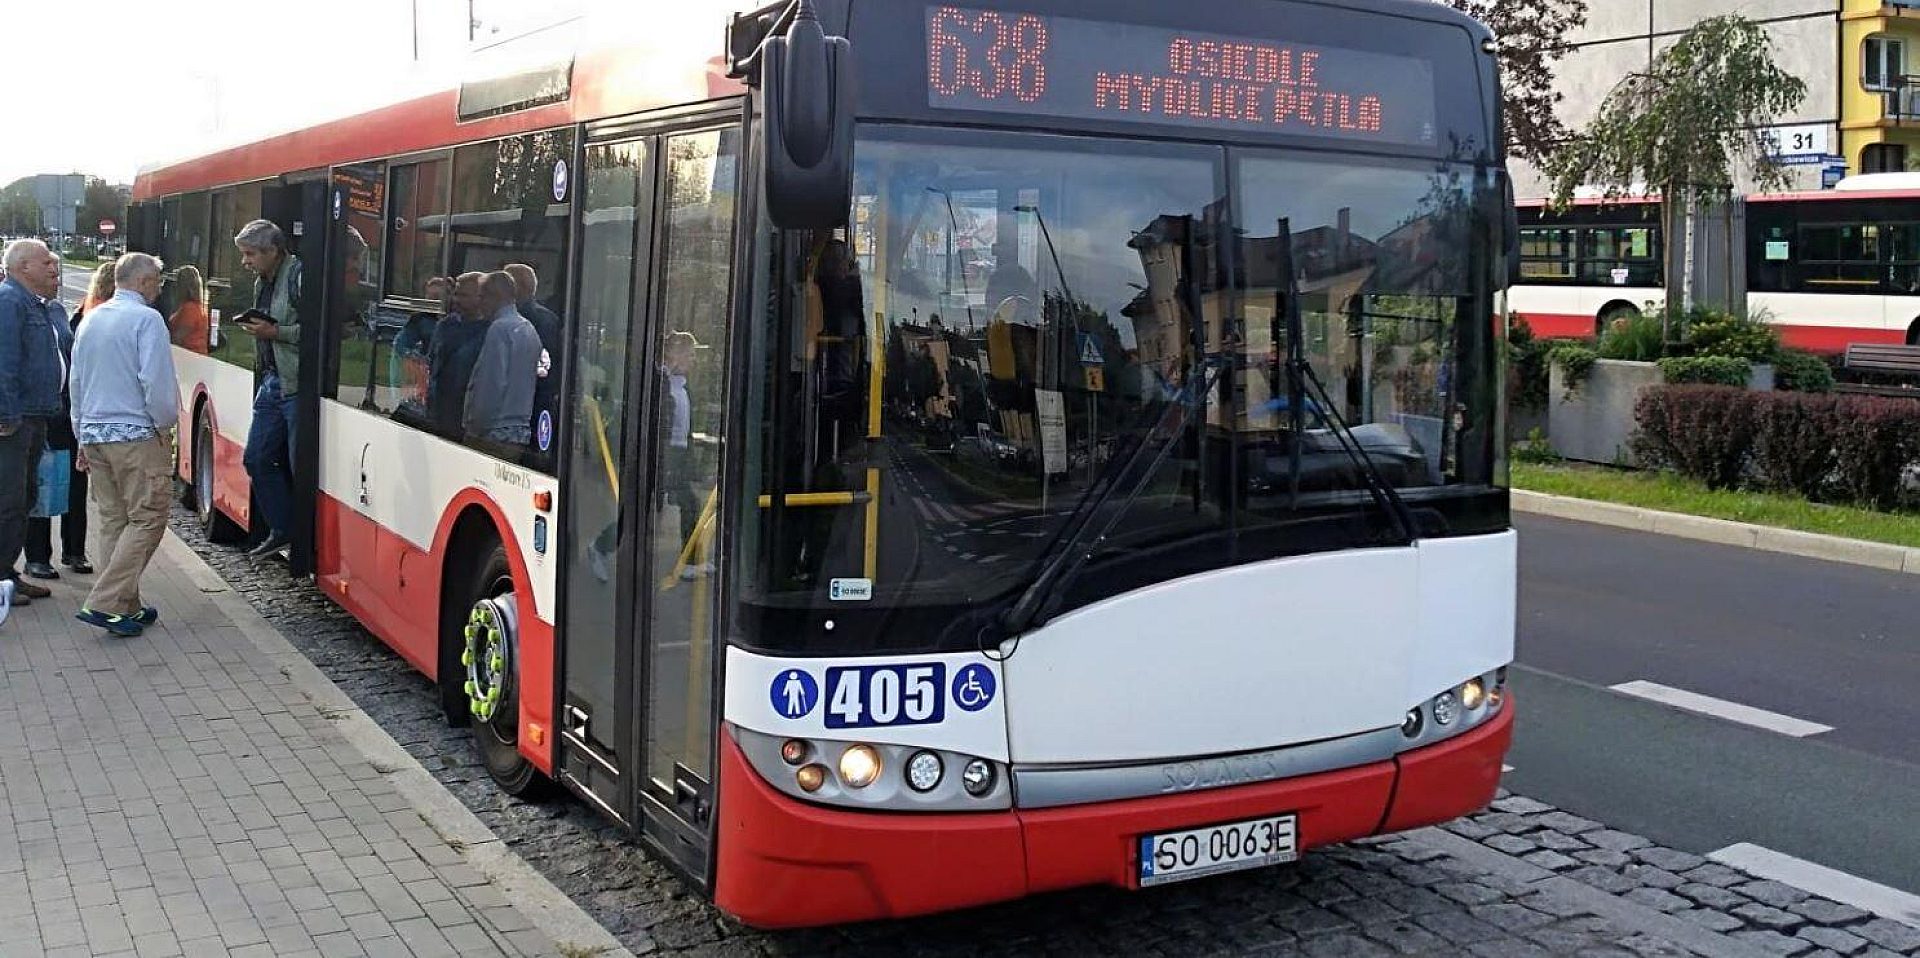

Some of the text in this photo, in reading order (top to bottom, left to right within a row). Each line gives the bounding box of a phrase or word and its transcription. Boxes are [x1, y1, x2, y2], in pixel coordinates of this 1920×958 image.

[932, 7, 1046, 102] 638
[1169, 38, 1319, 87] OSIEDLE
[1096, 71, 1265, 122] MYDLICE
[1792, 132, 1814, 150] 31
[830, 667, 935, 723] 405
[1162, 754, 1277, 792] SOLARIS
[1158, 820, 1292, 870] SO 0063E
